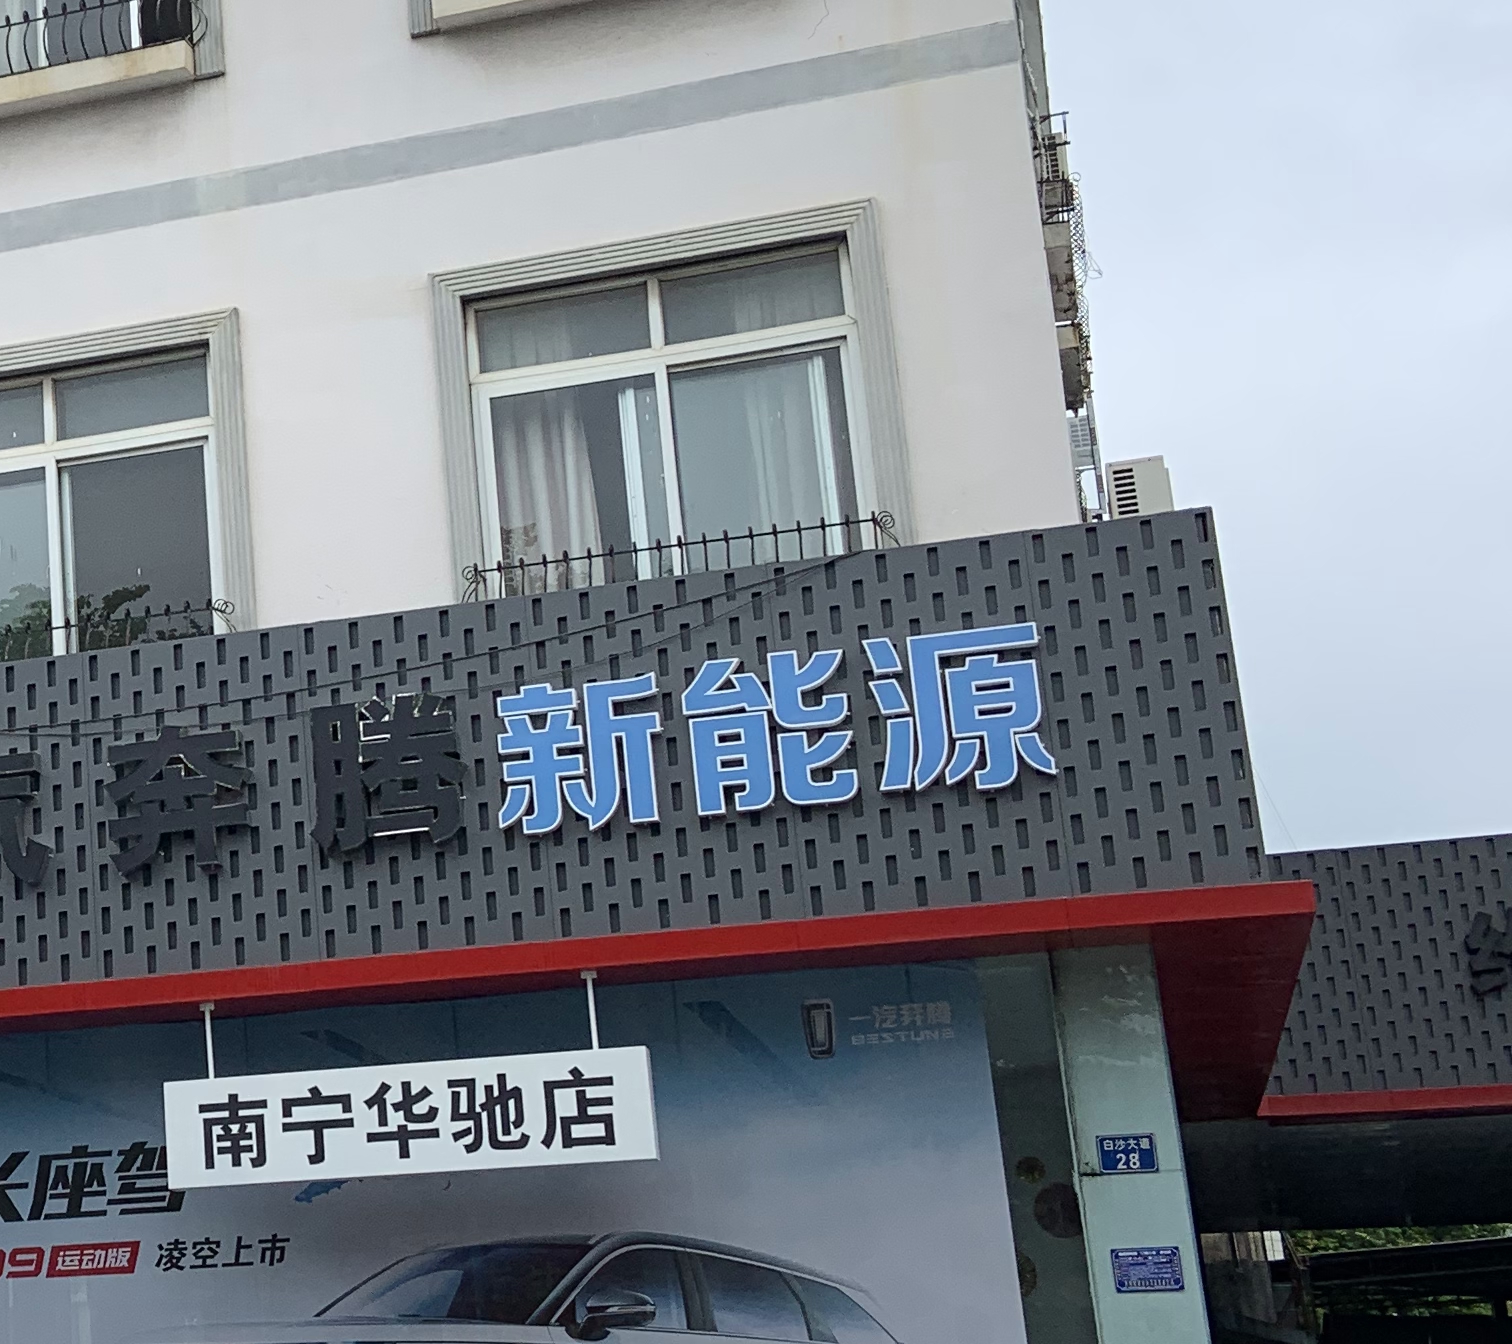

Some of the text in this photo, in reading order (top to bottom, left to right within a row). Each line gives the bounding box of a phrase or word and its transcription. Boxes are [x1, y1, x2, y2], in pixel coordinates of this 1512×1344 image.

[851, 1027, 955, 1046] BESTUNE
[198, 1066, 616, 1170] 南宁华驰店
[1102, 1137, 1151, 1151] 白沙大道
[1116, 1153, 1141, 1170] 28
[153, 1233, 291, 1273] 凌空上市
